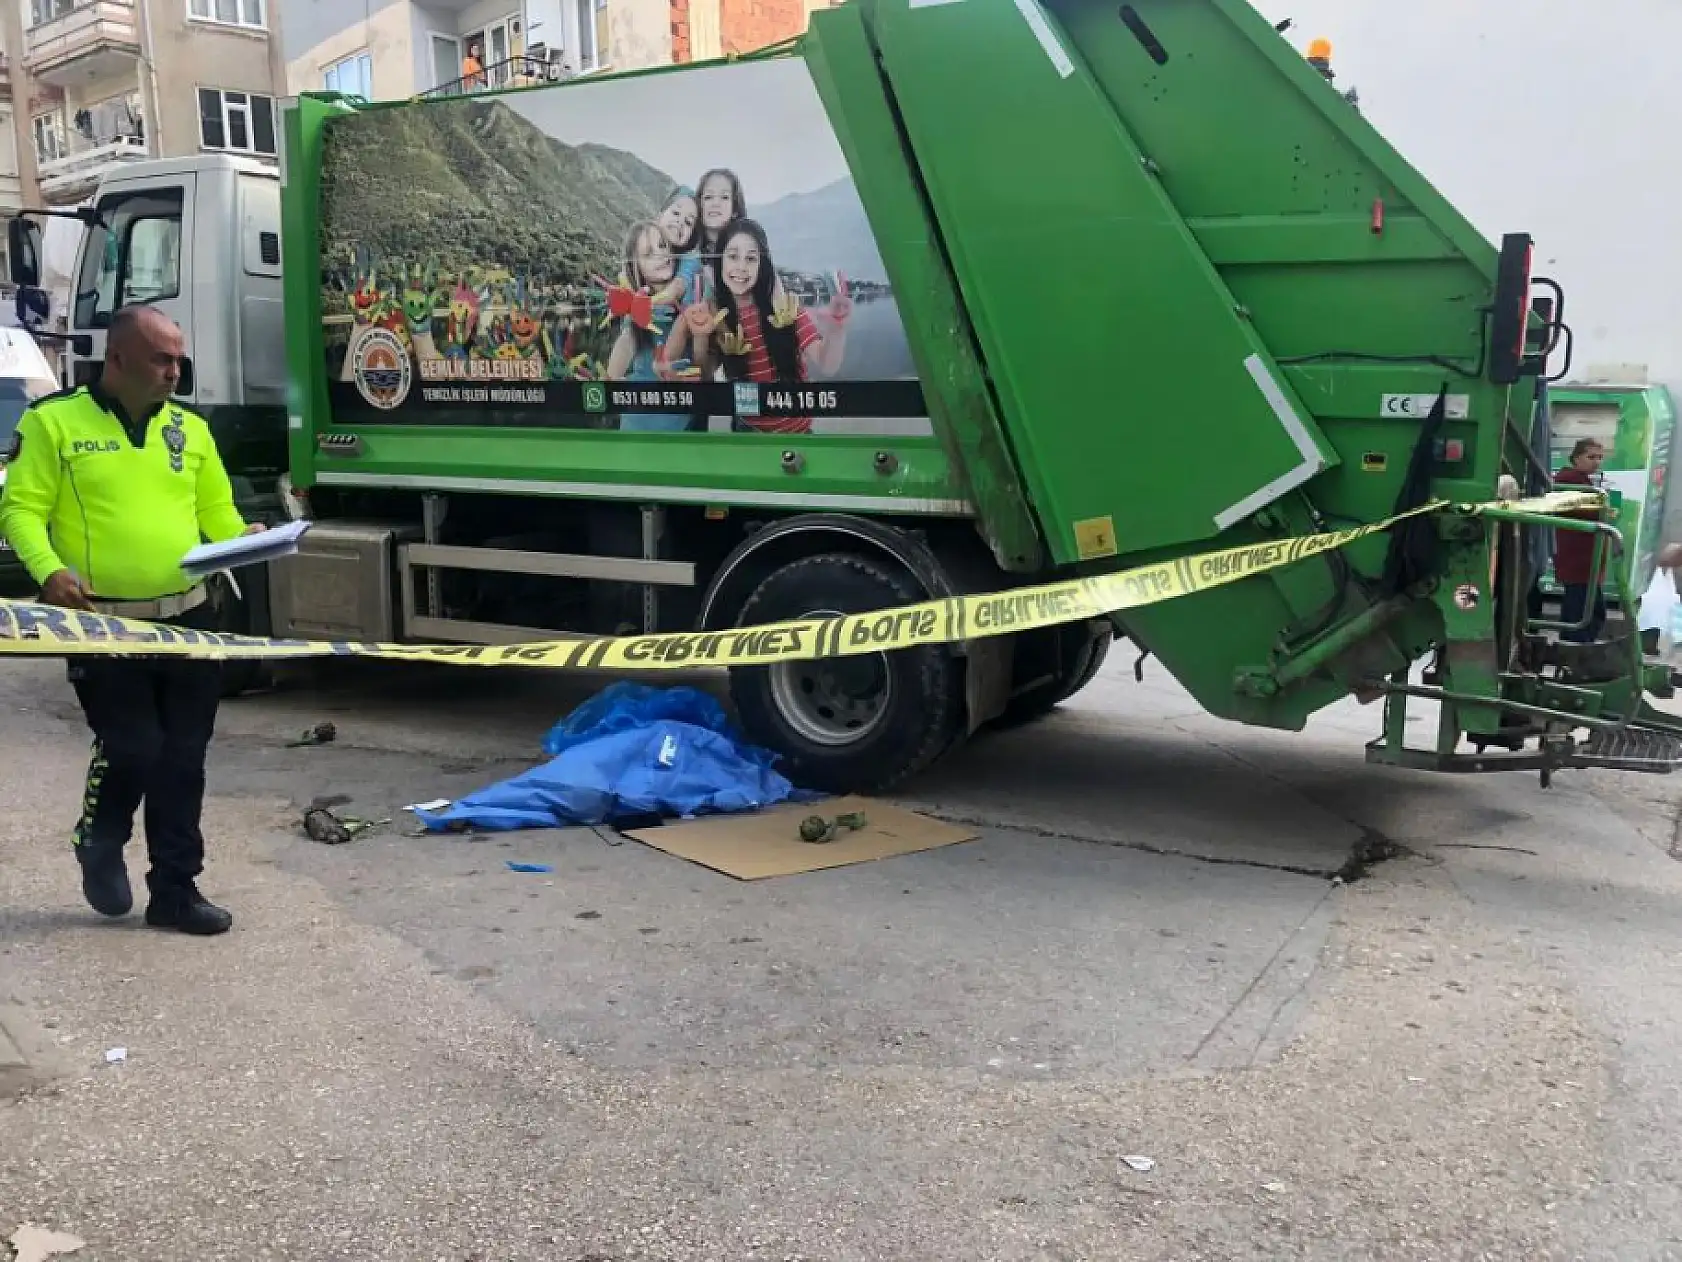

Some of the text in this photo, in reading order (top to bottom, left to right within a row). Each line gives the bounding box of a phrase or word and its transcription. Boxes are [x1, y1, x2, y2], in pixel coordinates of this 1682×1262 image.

[767, 390, 836, 408] 444 16 05
[1387, 397, 1411, 412] CE
